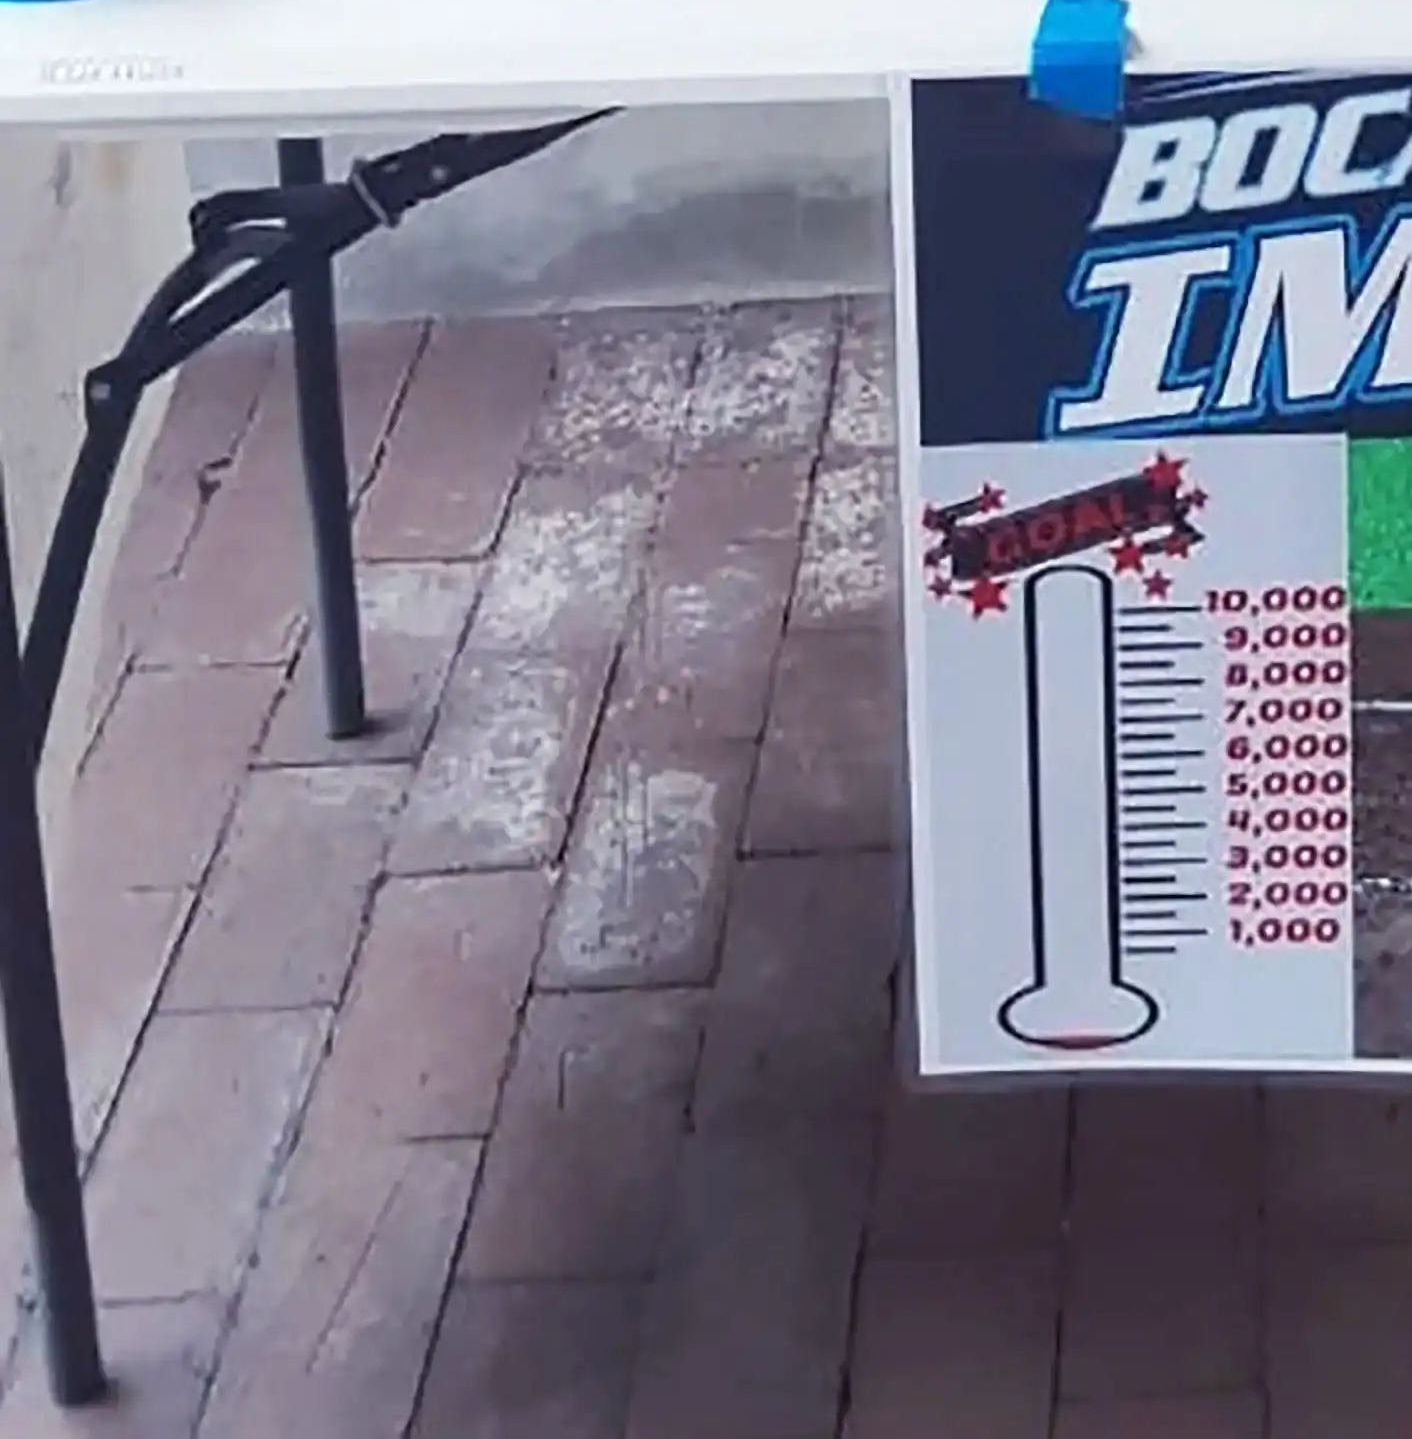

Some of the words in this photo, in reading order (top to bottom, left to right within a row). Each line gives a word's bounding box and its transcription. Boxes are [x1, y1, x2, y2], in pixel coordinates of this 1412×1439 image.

[1205, 585, 1346, 617] 10,000
[1224, 622, 1347, 654] 9,000
[1225, 660, 1347, 691] 8,000
[1225, 697, 1343, 727] 7,000
[1226, 734, 1348, 764] 6,000
[1226, 770, 1346, 800] 5,000
[1227, 807, 1348, 837] 4,000
[1226, 844, 1347, 874] 3,000
[1228, 881, 1348, 911] 2,000
[1229, 918, 1341, 947] 1,000
